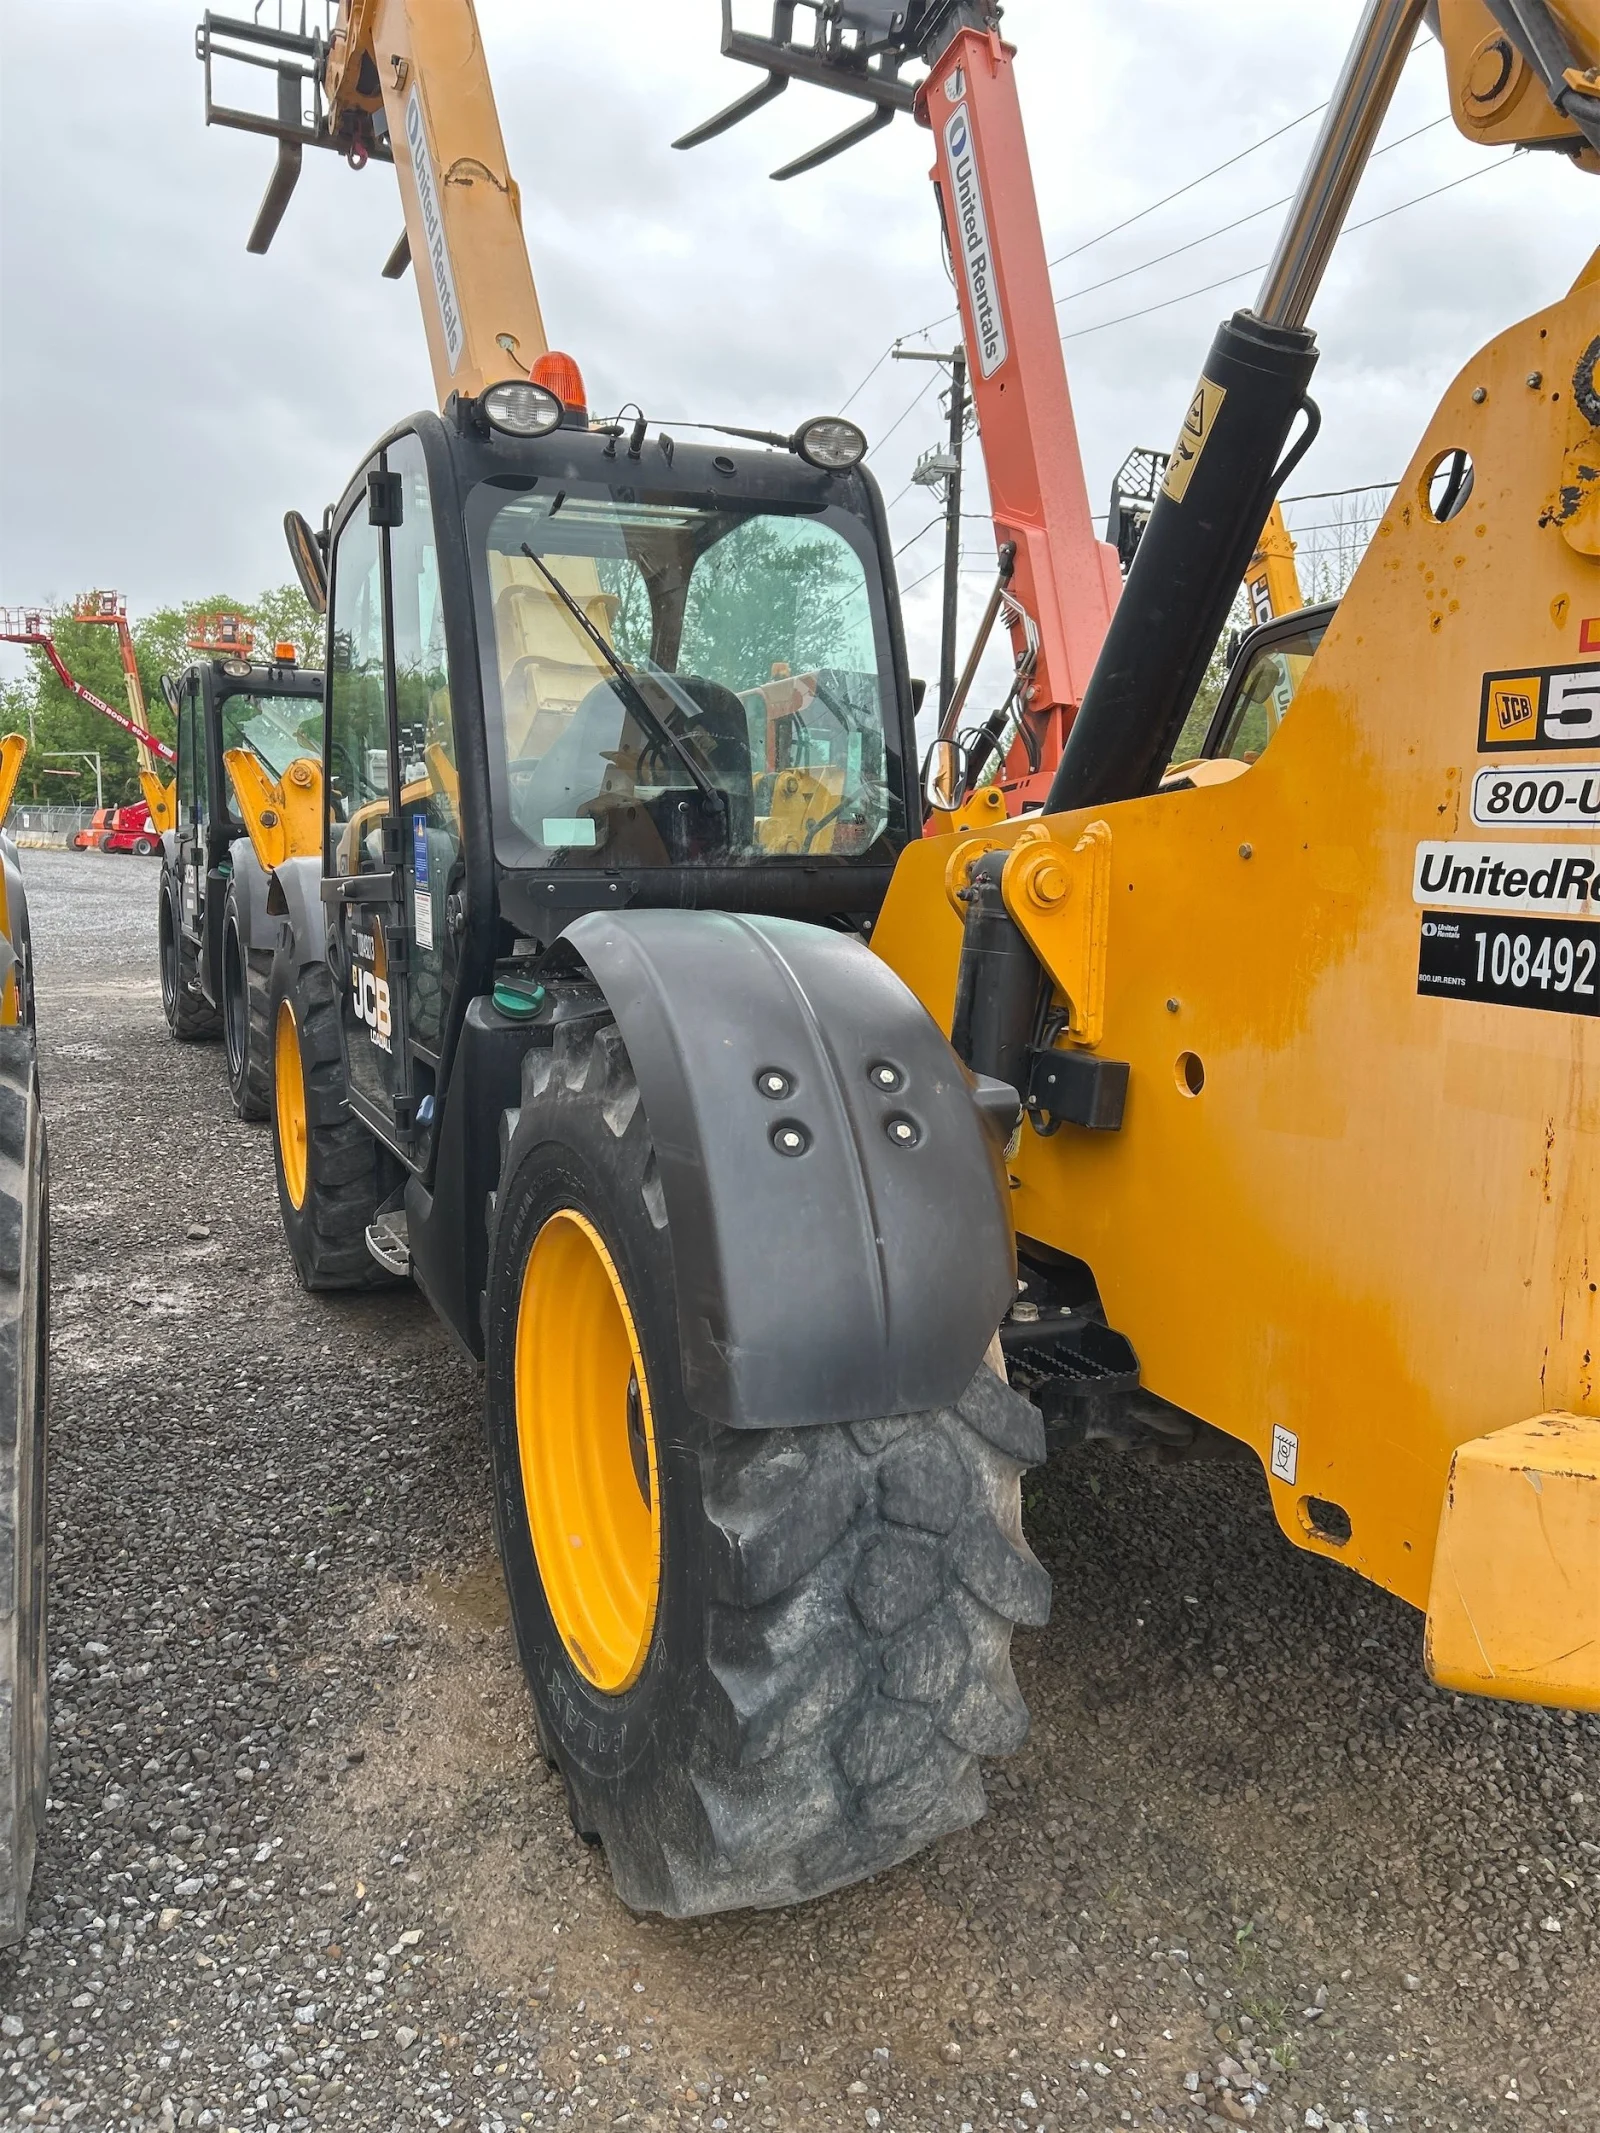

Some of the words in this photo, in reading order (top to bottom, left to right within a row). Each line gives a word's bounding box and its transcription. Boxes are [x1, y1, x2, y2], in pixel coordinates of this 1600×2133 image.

[414, 136, 438, 241] United
[432, 233, 458, 353] Rentals
[956, 155, 984, 253] United
[971, 252, 999, 360] Rentals
[106, 707, 130, 727] BOOM
[1501, 696, 1530, 725] JCB
[1437, 923, 1460, 932] United
[1437, 930, 1461, 939] Rentals
[1475, 932, 1597, 995] 108492
[1418, 973, 1467, 986] 800.UR.RENTS
[353, 965, 392, 1038] JCB
